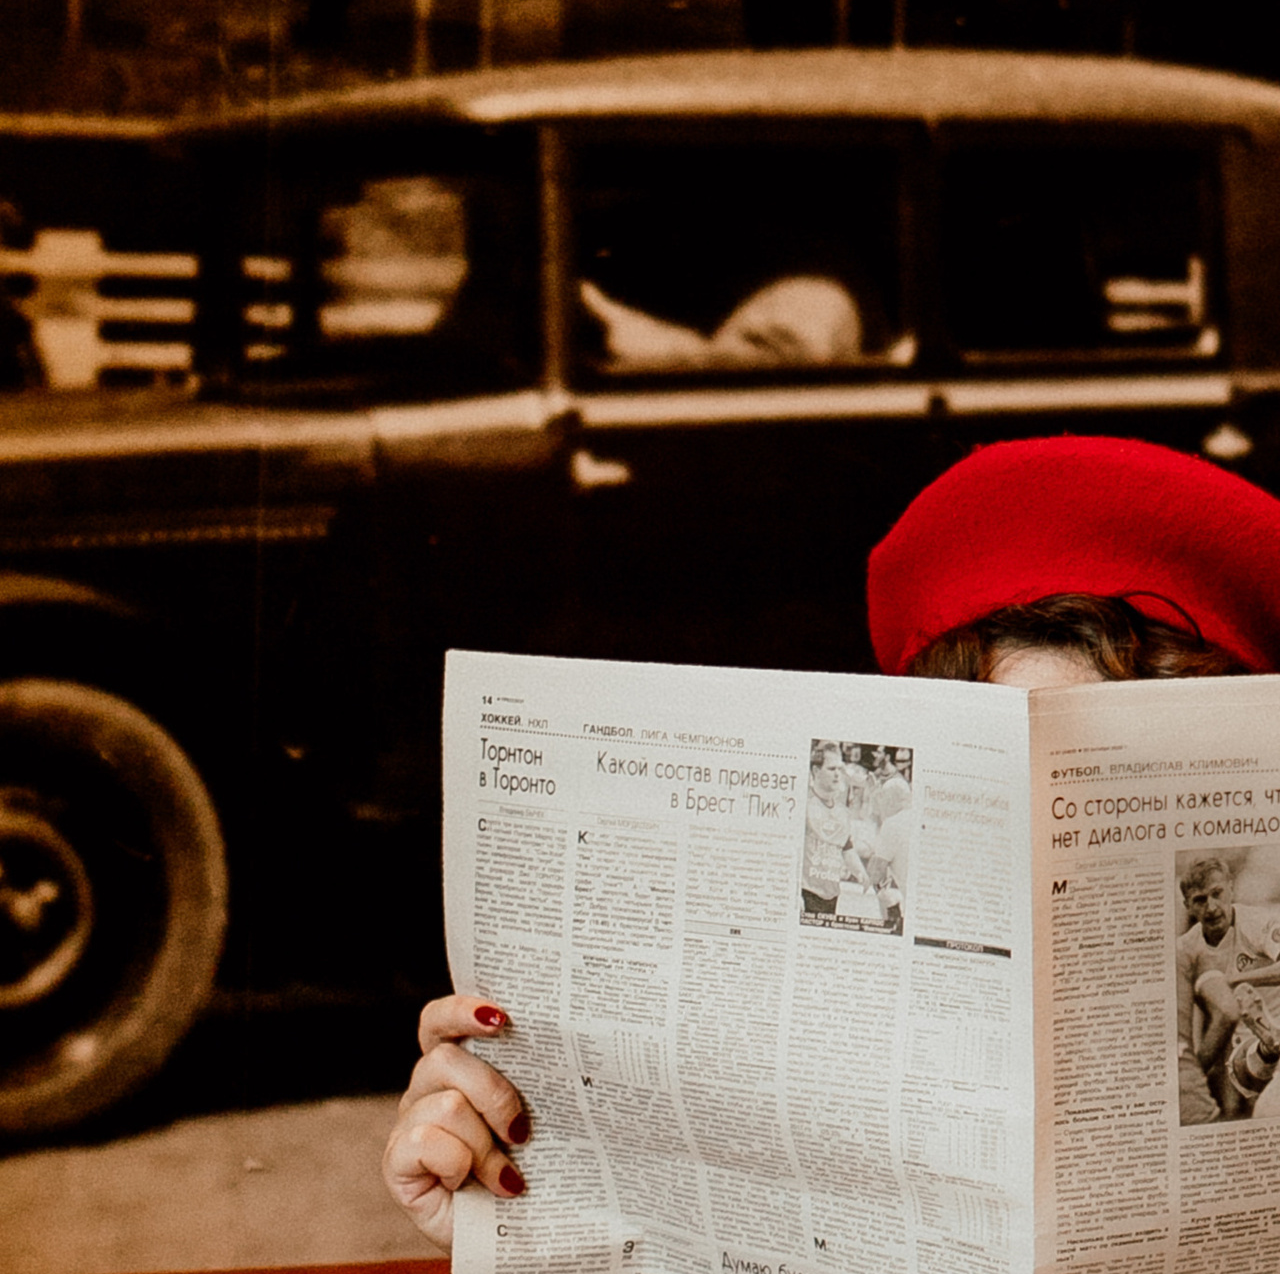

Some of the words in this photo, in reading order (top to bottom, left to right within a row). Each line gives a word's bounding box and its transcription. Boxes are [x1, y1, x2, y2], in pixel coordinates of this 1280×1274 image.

[482, 695, 494, 706] 14
[528, 718, 549, 729] НХЛ
[640, 728, 669, 742] ЛИГА
[673, 732, 745, 748] ЧЕМПИОНОВ
[480, 737, 543, 768] Торнтон
[1110, 760, 1184, 775] ВЛАДИСЛАВ
[1189, 757, 1259, 771] КЛИМОВИЧ
[479, 770, 488, 788] в
[493, 767, 556, 797] Торонто
[597, 750, 648, 777] Какой
[654, 762, 712, 783] состав
[718, 767, 797, 792] привезет
[669, 792, 680, 809] в
[685, 788, 735, 816] Брест
[1051, 796, 1078, 820] Со
[1084, 795, 1167, 819] стороны
[1176, 790, 1256, 810] кажется,
[1052, 830, 1081, 849] нет
[1087, 823, 1167, 847] диалога
[1175, 822, 1186, 838] с
